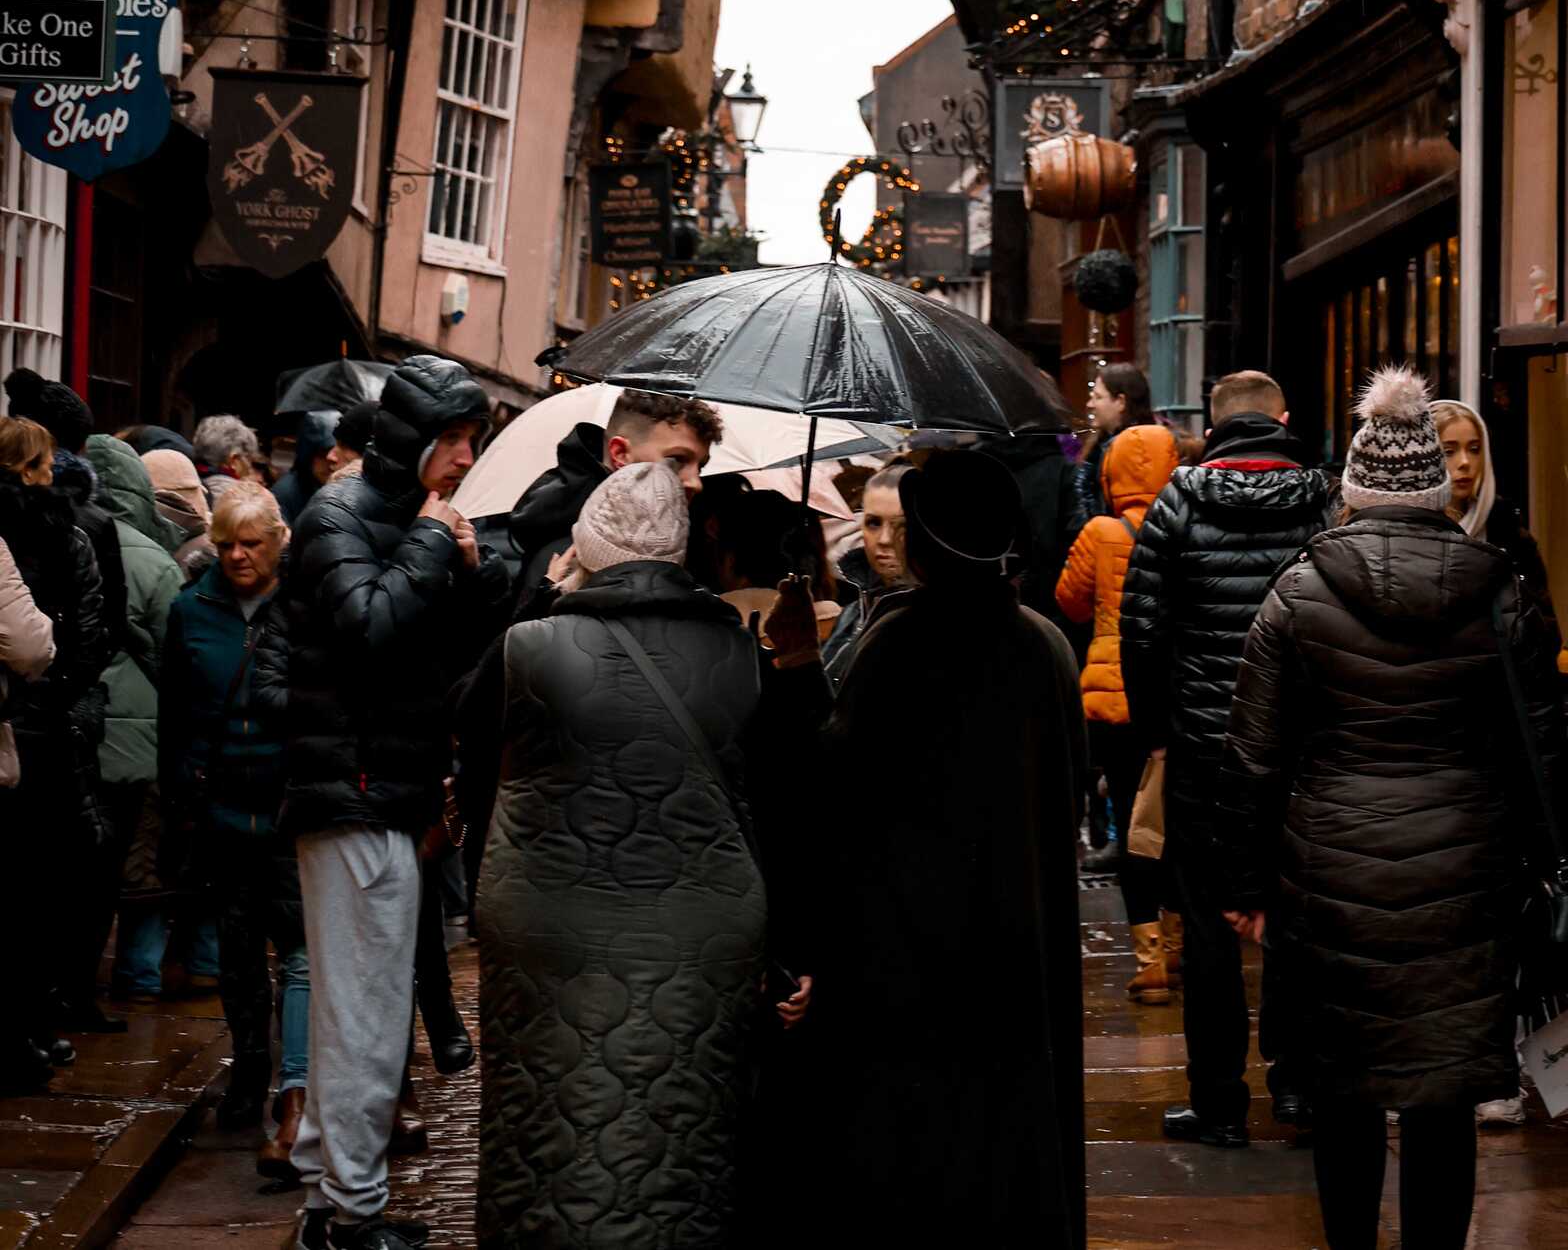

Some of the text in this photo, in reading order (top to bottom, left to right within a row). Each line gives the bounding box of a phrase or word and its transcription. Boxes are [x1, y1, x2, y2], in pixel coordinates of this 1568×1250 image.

[0, 11, 94, 38] ke One
[0, 42, 62, 67] Gifts
[47, 101, 130, 152] Shop
[1045, 109, 1061, 128] S
[274, 204, 320, 222] GHOST
